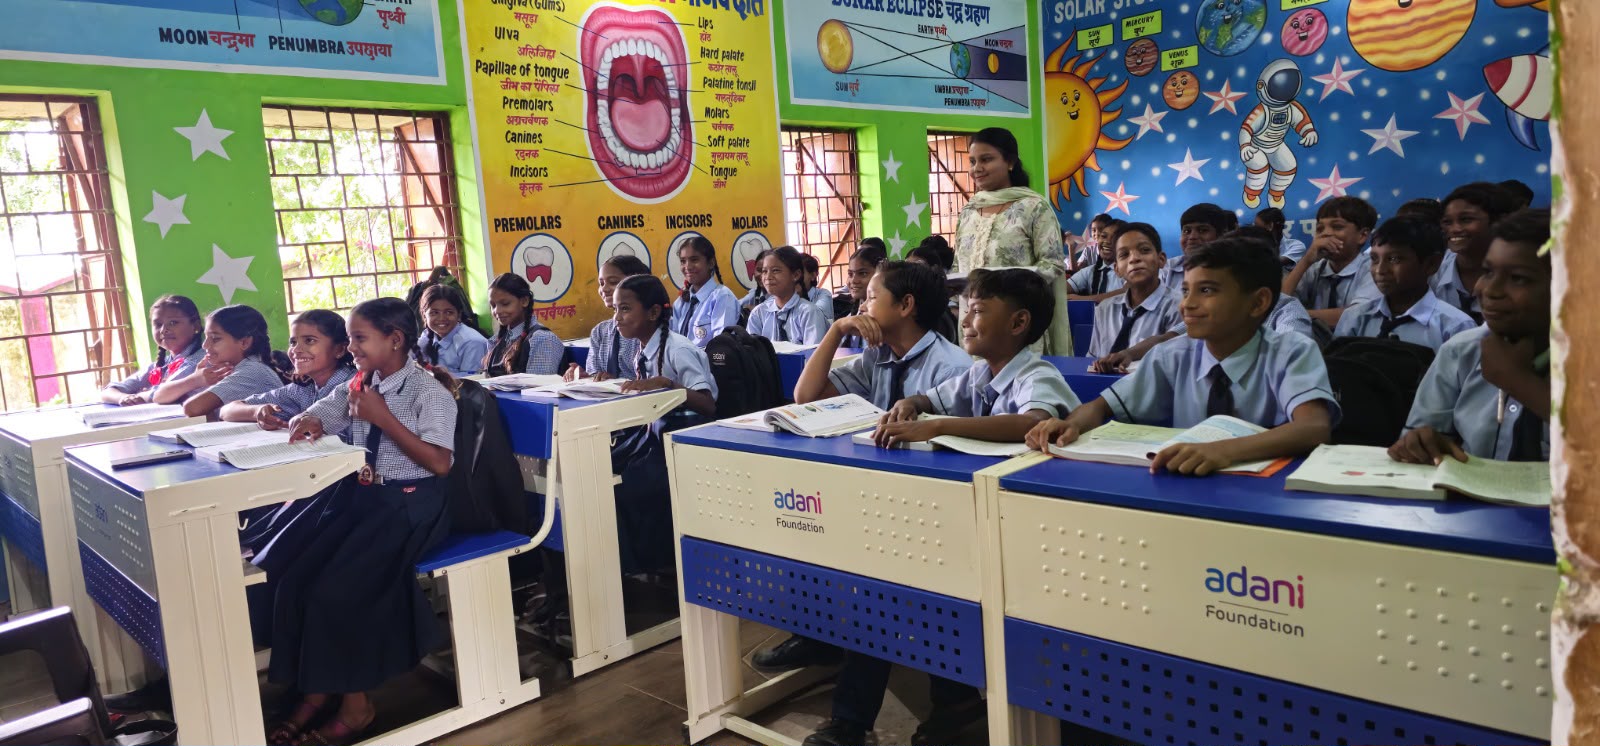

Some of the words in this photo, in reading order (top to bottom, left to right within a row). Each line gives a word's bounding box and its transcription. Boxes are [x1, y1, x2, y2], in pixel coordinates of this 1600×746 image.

[376, 7, 406, 29] पृथ्वी
[887, 0, 944, 18] ECLIPSE
[964, 4, 990, 27] ग्रहण
[1054, 0, 1105, 23] SOLAR
[698, 16, 714, 30] Lips
[1126, 16, 1155, 28] MERCURY
[159, 27, 208, 45] MOON
[208, 31, 256, 53] चन्द्रमा
[495, 26, 520, 40] Ulva
[268, 35, 346, 54] PENUMBRA
[700, 46, 720, 60] Hard
[722, 49, 744, 62] palate
[1168, 50, 1188, 58] VENUS
[475, 59, 517, 76] Papillae
[520, 63, 531, 76] of
[534, 63, 570, 82] tongue
[500, 77, 520, 92] जीभ
[520, 82, 532, 92] का
[703, 76, 734, 90] Palatine
[736, 77, 756, 91] tonsil
[502, 96, 554, 111] Premolars
[705, 106, 730, 118] Molars
[505, 130, 542, 144] Canines
[708, 135, 724, 147] Soft
[728, 137, 750, 150] palate
[510, 164, 548, 178] Incisors
[710, 165, 738, 180] Tongue
[494, 215, 562, 232] PREMOLARS
[598, 214, 645, 230] CANINES
[666, 214, 712, 230] INCISORS
[732, 215, 768, 230] MOLARS
[774, 488, 822, 514] adani
[776, 518, 824, 534] Foundation
[1205, 566, 1304, 609] adani
[1206, 604, 1304, 638] Foundation
